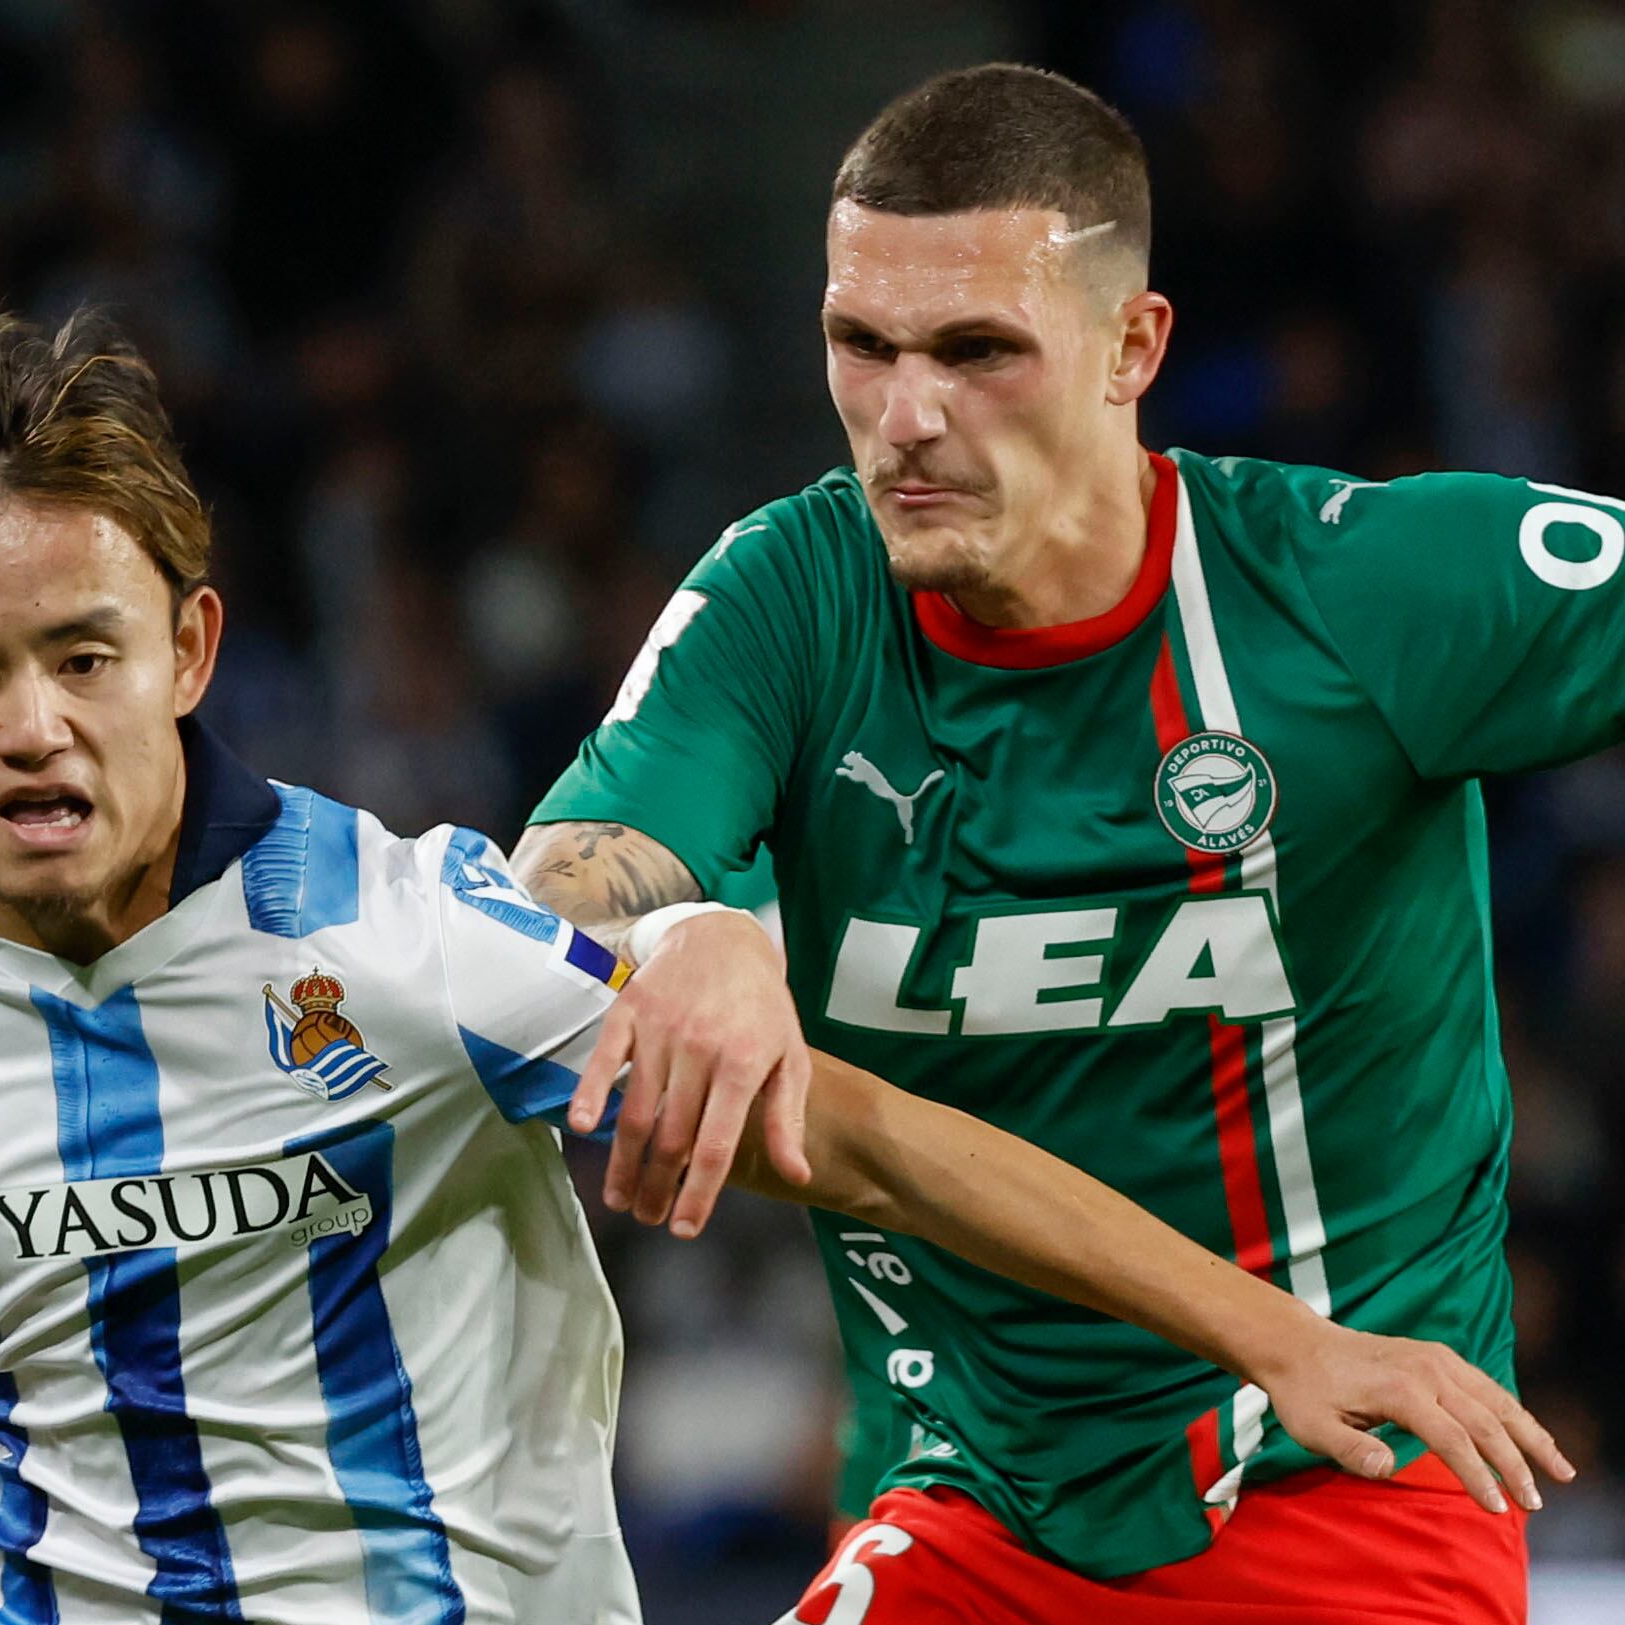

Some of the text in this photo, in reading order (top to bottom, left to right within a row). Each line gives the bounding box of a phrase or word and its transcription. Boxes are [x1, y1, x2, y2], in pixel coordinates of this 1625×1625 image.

[1167, 738, 1246, 773] DEPORTIVO
[824, 895, 1297, 1036] LEA
[289, 1204, 372, 1249] group
